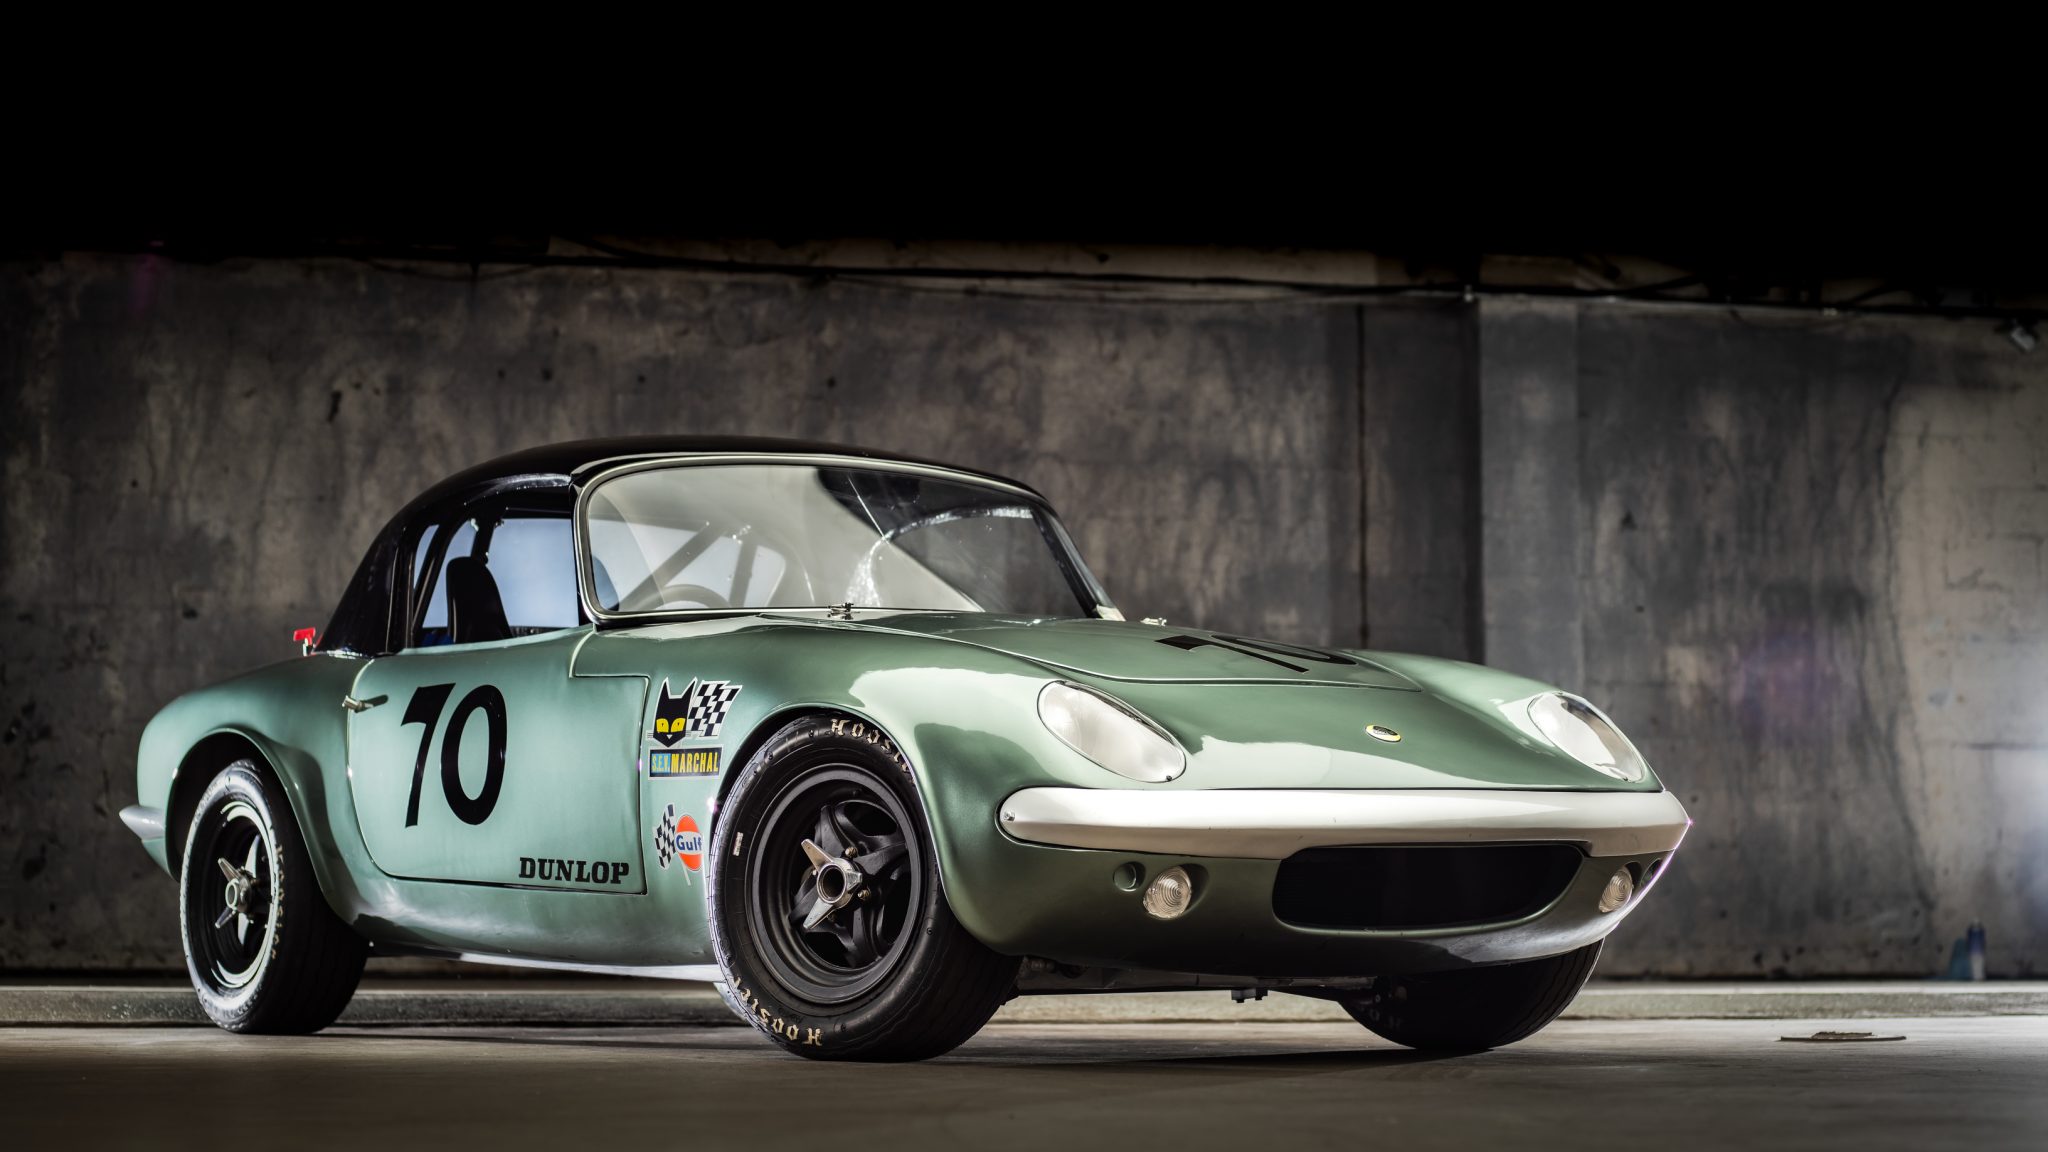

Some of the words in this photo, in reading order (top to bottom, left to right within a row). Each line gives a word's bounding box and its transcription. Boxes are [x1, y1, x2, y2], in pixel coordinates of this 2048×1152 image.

[1154, 634, 1357, 673] 70
[400, 682, 508, 828] 70
[671, 752, 719, 773] MARCHAL
[676, 834, 702, 851] Gulf
[518, 856, 630, 884] DUNLOP
